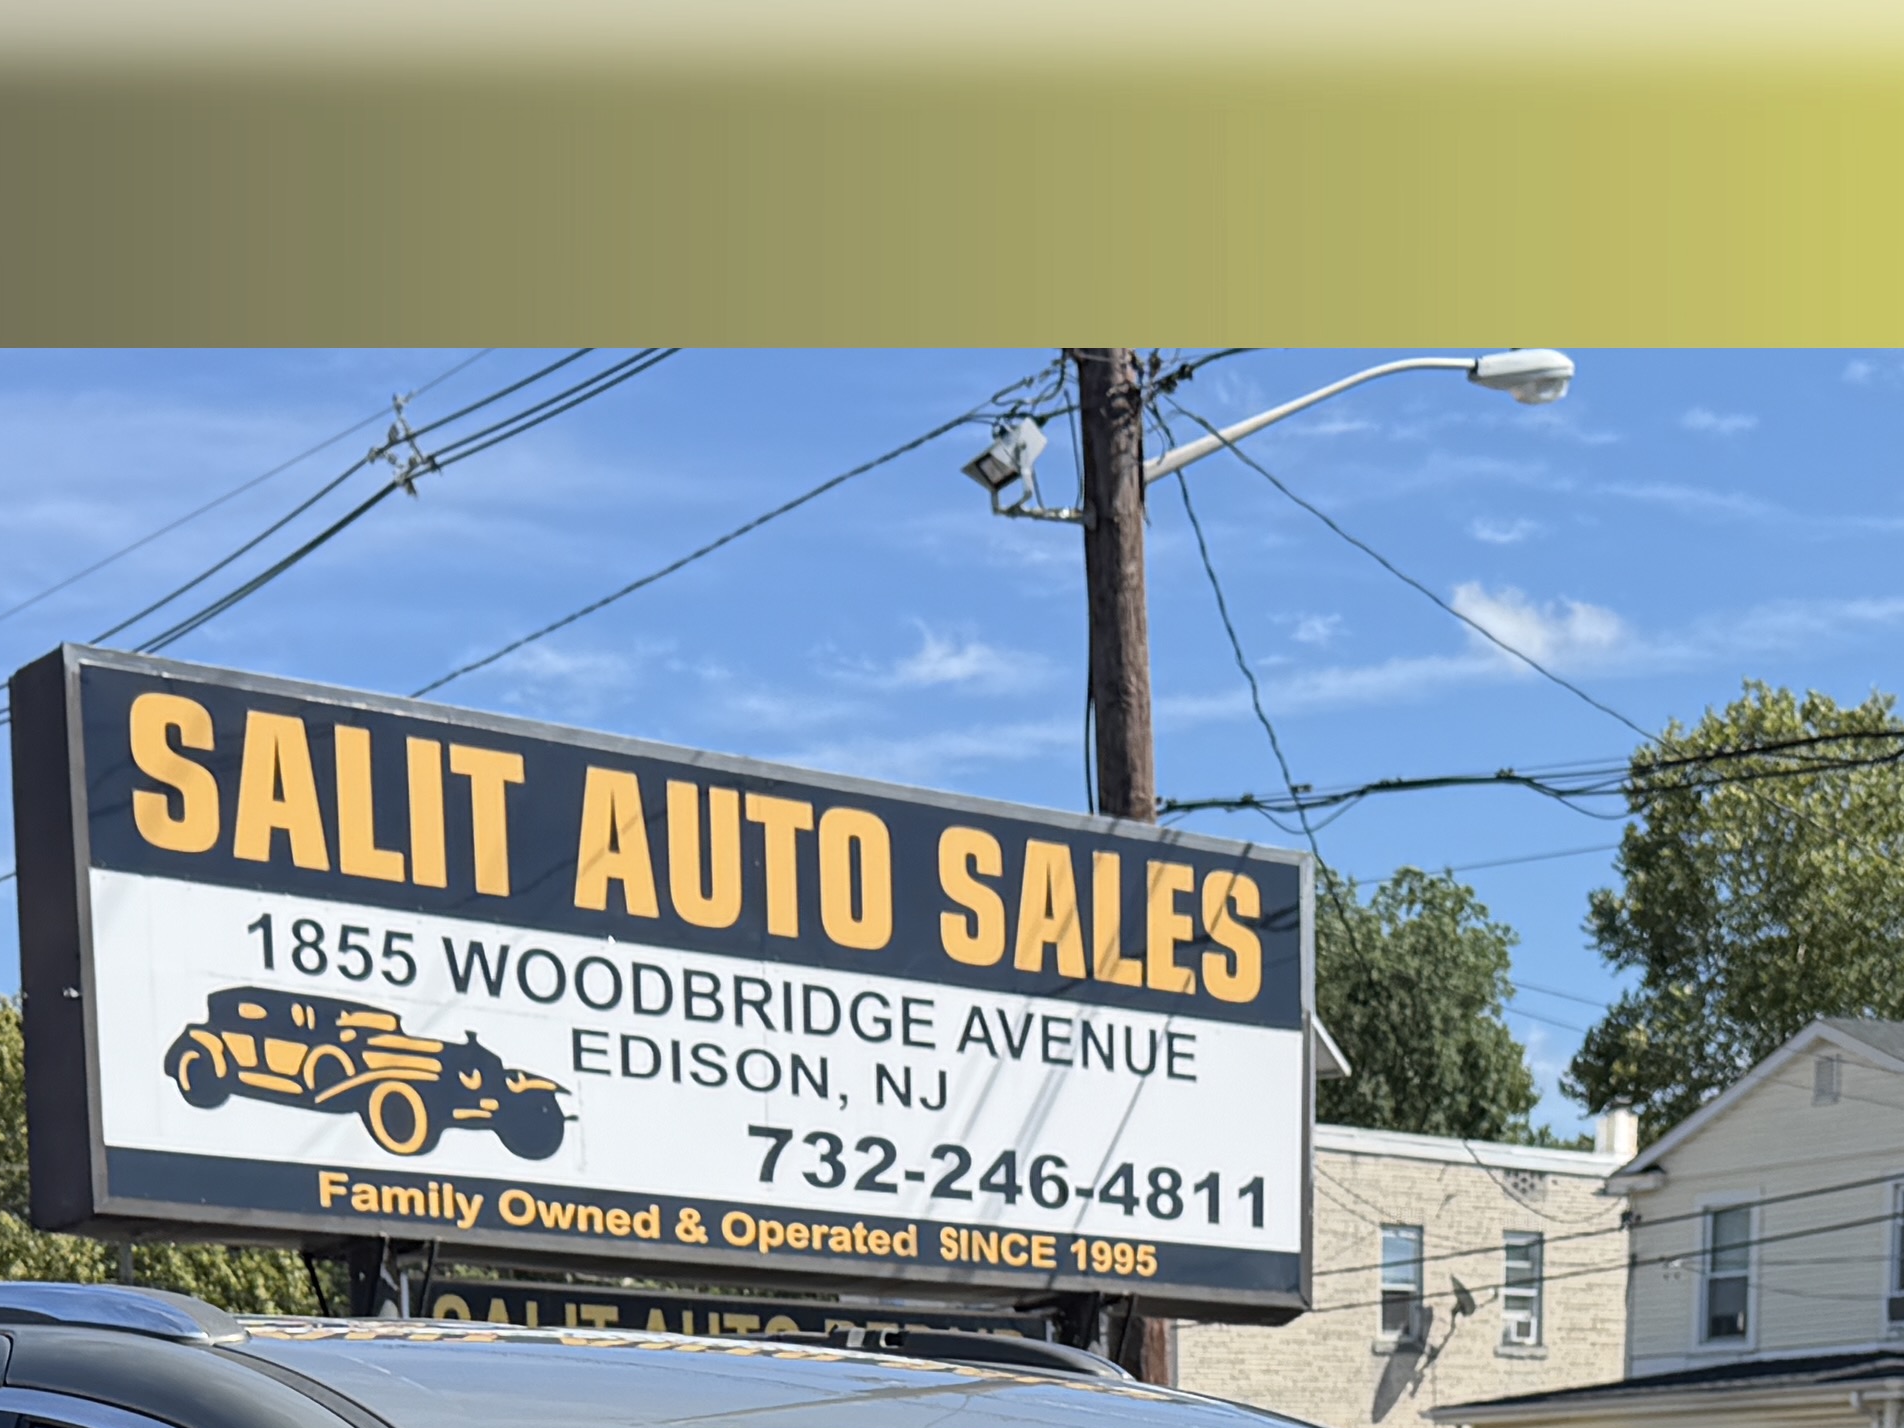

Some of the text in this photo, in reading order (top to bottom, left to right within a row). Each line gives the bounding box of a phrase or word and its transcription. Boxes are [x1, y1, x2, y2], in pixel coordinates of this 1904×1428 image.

[129, 692, 1262, 1003] SALIT AUTO SALES
[247, 912, 1198, 1083] 1855 WOODBRIDGE AVENUE
[571, 1028, 948, 1111] EDISON, NJ
[317, 1170, 1158, 1277] Family Owned & Operated SINCE 1995
[747, 1124, 1266, 1229] 732-246-4811
